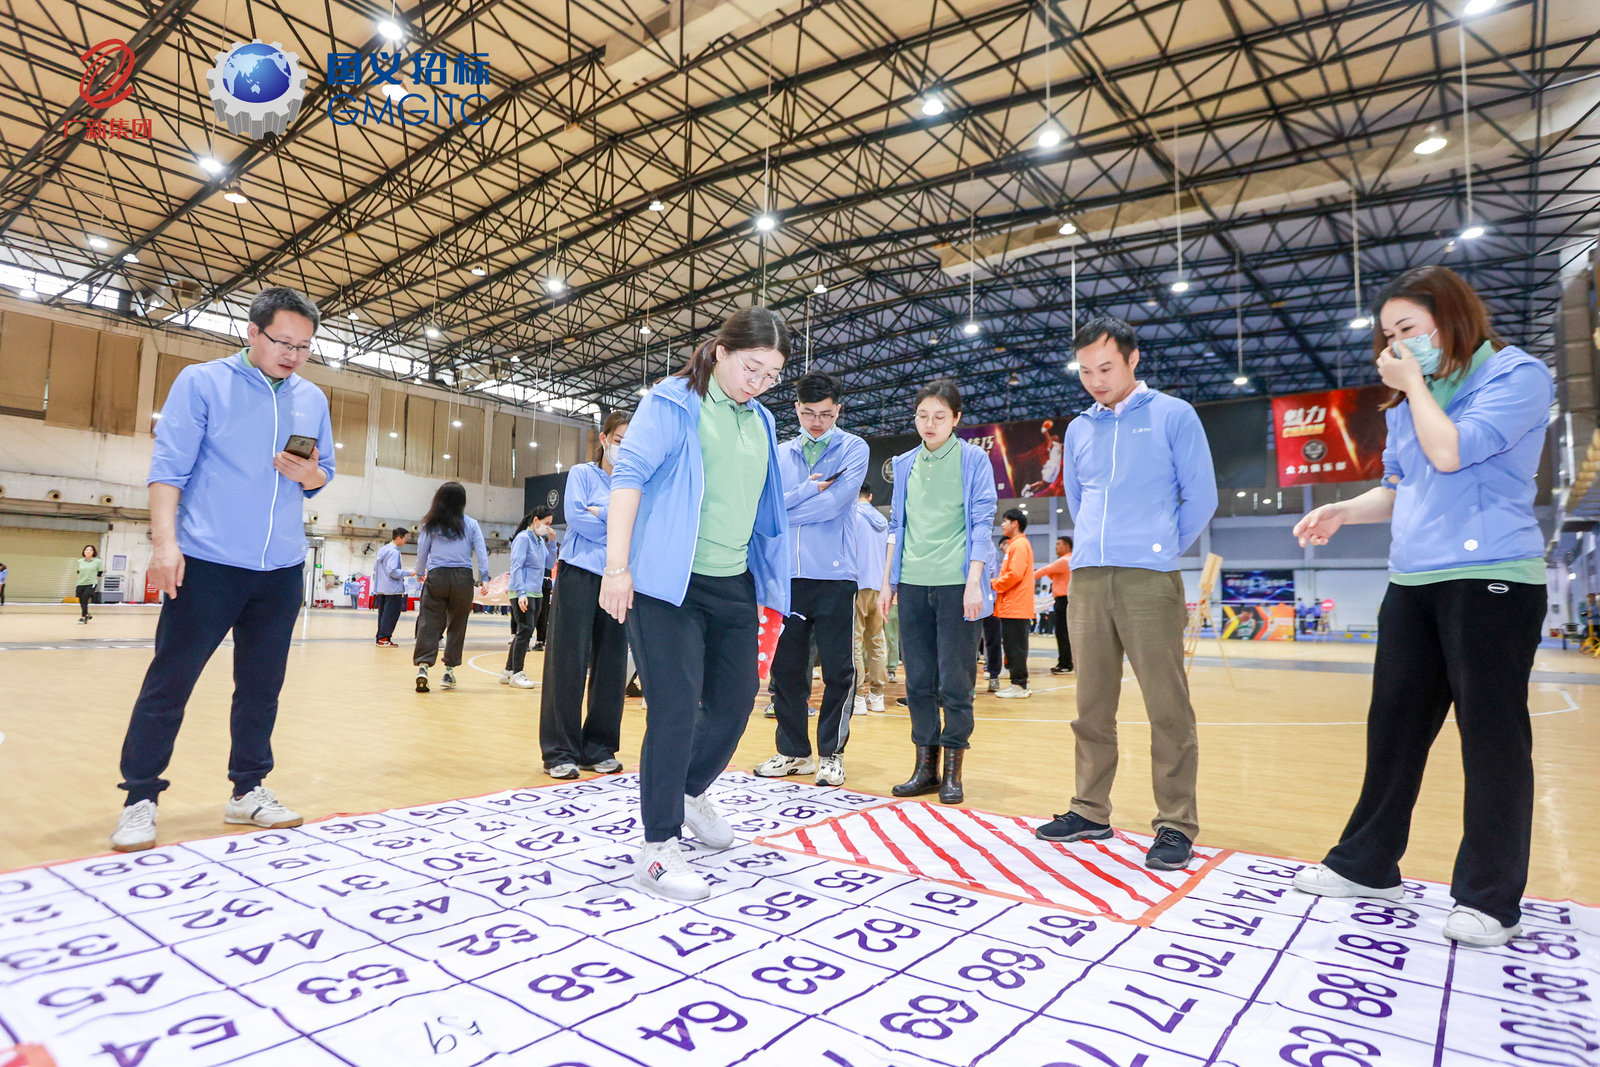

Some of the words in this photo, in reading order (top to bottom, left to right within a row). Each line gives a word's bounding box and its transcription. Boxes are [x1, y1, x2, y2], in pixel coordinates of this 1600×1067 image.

[487, 792, 542, 806] 04
[320, 819, 386, 834] 06
[515, 831, 581, 852] 29
[591, 817, 637, 836] 28
[225, 834, 291, 855] 07
[85, 853, 174, 876] 08
[422, 851, 498, 872] 30
[582, 853, 637, 870] 41
[1247, 859, 1303, 879] 73
[129, 872, 219, 899] 20
[318, 874, 390, 897] 31
[478, 870, 554, 897] 42
[814, 869, 884, 893] 55
[1222, 881, 1287, 904] 74
[169, 898, 273, 929] 32
[369, 895, 450, 925] 43
[738, 891, 817, 922] 56
[910, 891, 977, 916] 61
[1350, 901, 1420, 930] 86
[834, 919, 921, 953] 62
[1027, 915, 1096, 946] 67
[1193, 909, 1263, 936] 75
[225, 928, 324, 965] 44
[438, 923, 538, 956] 52
[659, 922, 736, 957] 57
[1334, 933, 1411, 970] 87
[752, 955, 845, 995] 63
[958, 948, 1045, 989] 68
[1153, 943, 1236, 978] 76
[38, 972, 164, 1018] 45
[296, 964, 409, 1004] 53
[527, 963, 636, 1001] 58
[1308, 972, 1398, 1018] 88
[880, 995, 978, 1040] 69
[1108, 984, 1198, 1034] 77
[93, 1016, 239, 1067] 54
[636, 1001, 748, 1052] 64
